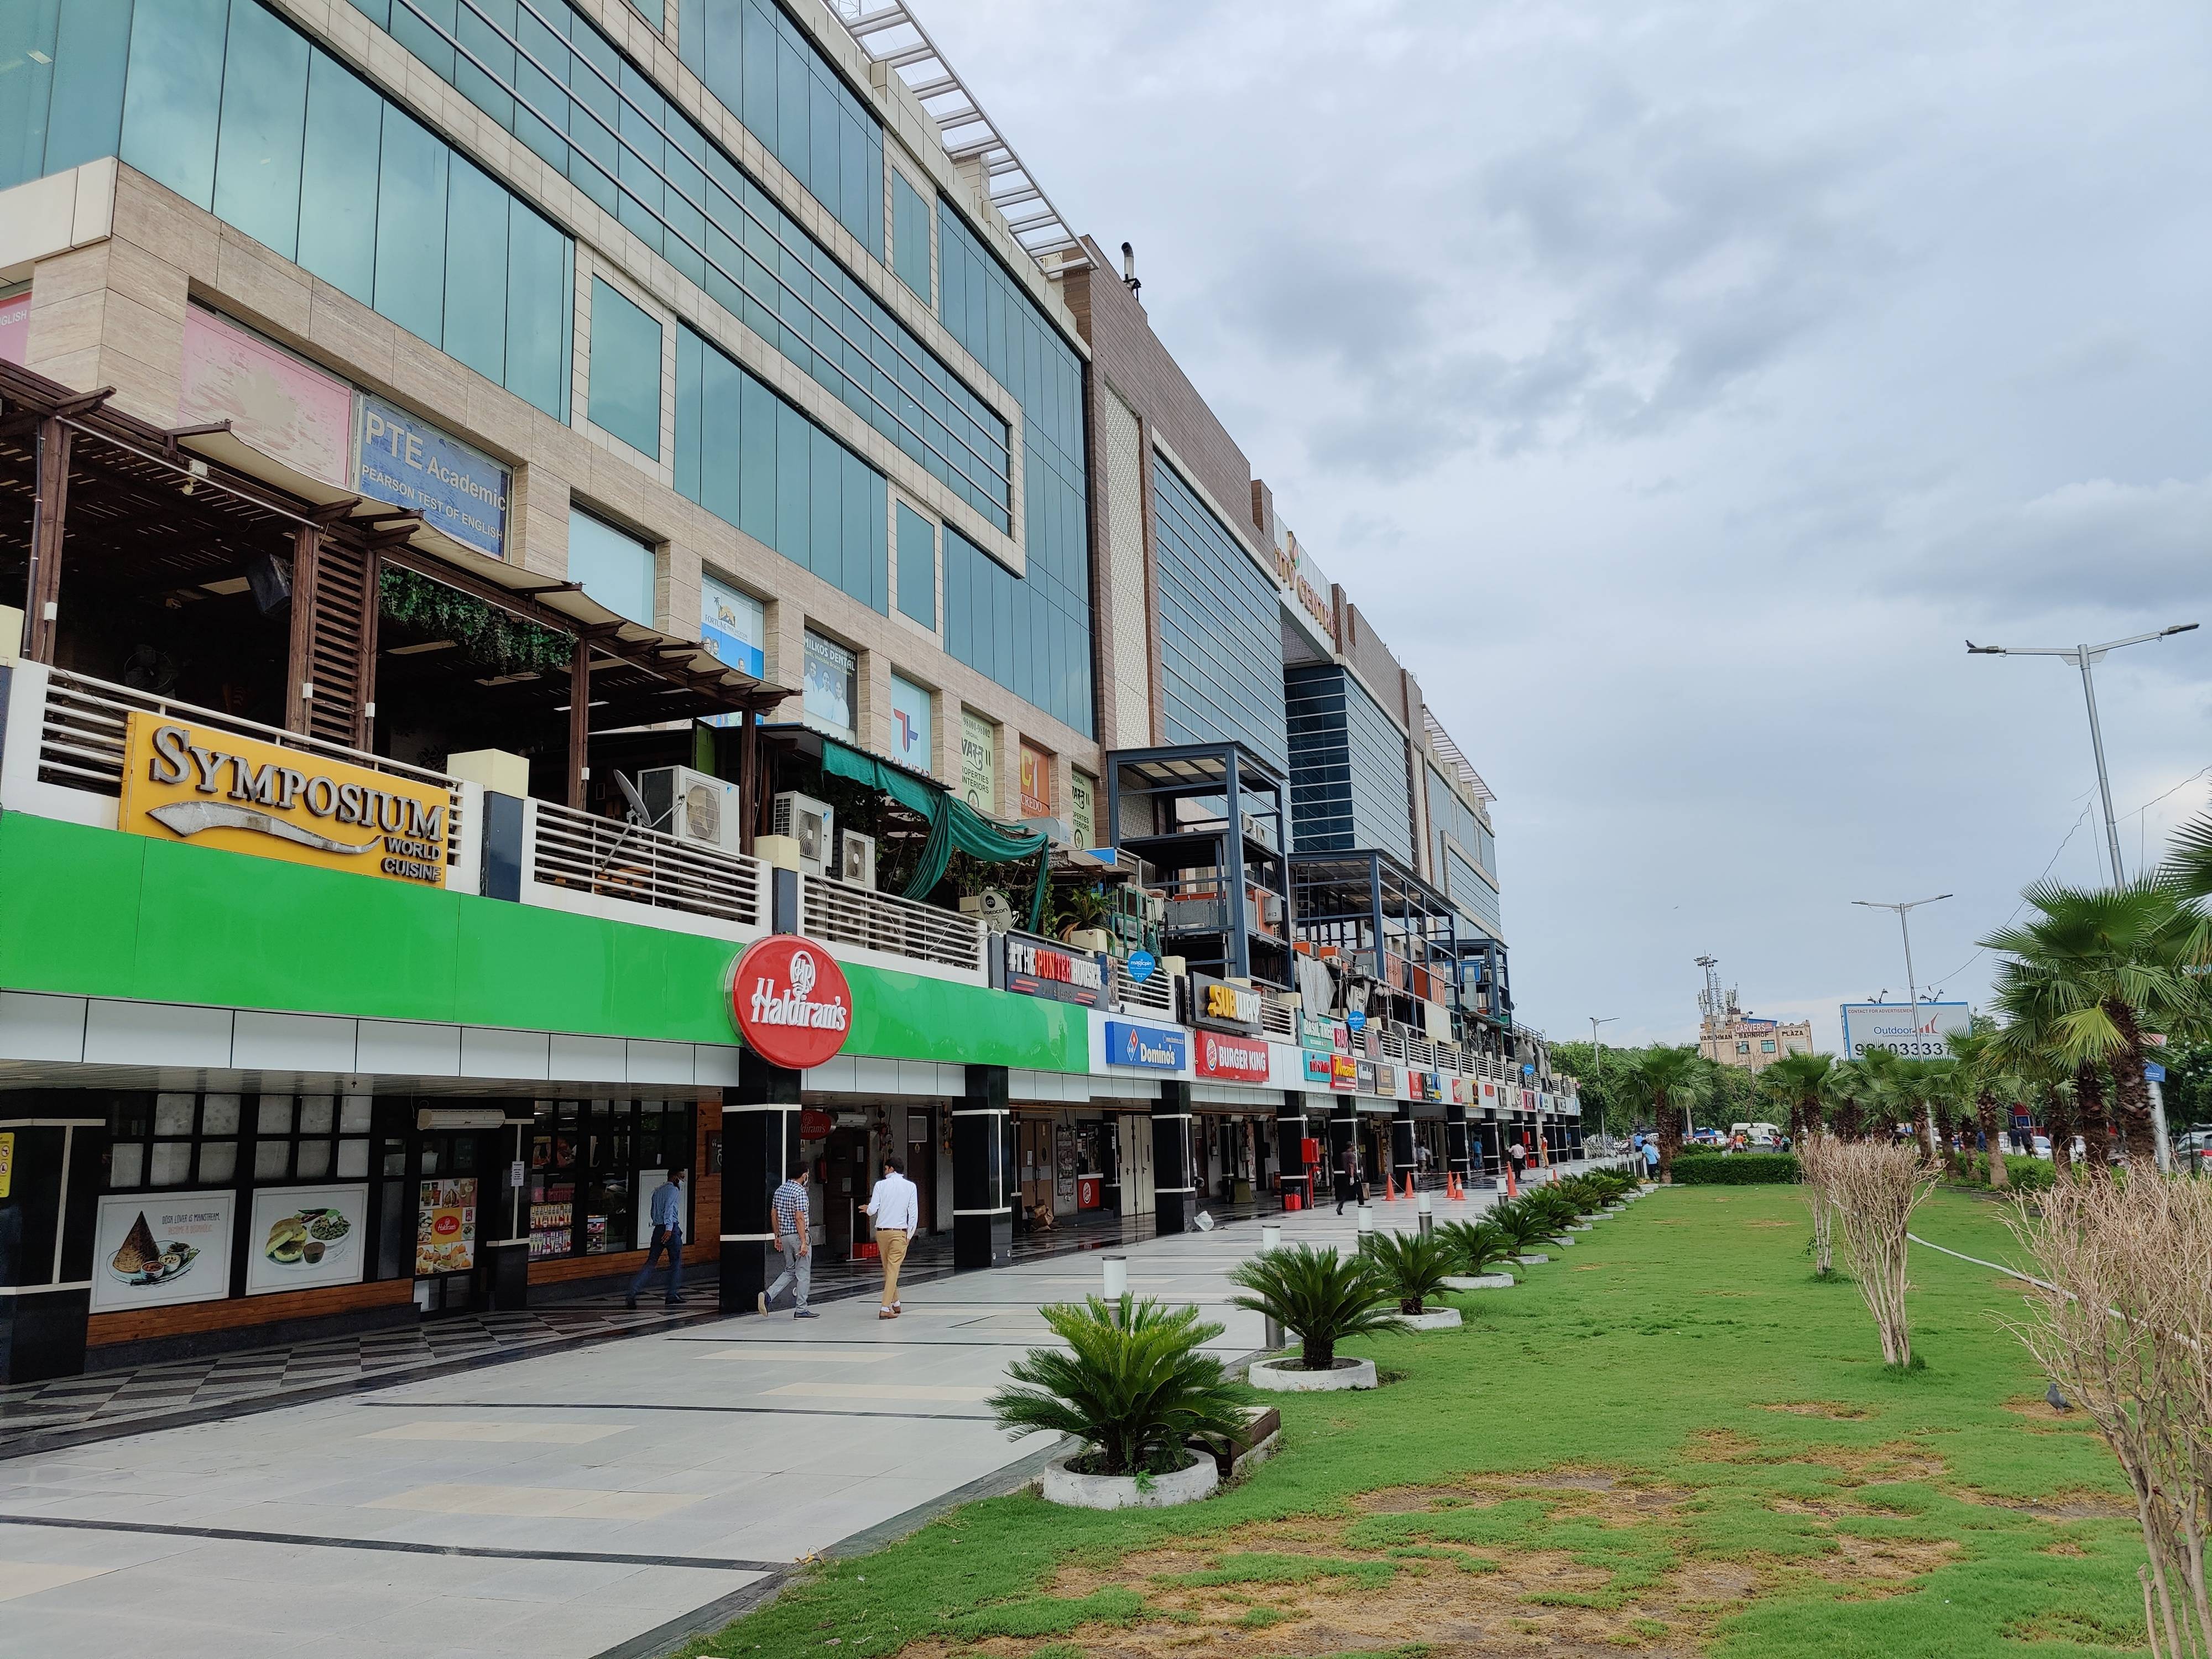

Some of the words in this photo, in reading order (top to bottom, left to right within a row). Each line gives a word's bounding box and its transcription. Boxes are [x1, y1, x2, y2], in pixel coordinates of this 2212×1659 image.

[0, 310, 27, 326] GLISH
[366, 411, 423, 470] PTE
[427, 456, 506, 512] Academic
[362, 464, 415, 499] PEARSON
[418, 491, 444, 513] TEST
[446, 507, 459, 519] OF
[462, 514, 503, 541] ENGLISH
[1297, 575, 1337, 640] CENTRE
[705, 614, 727, 630] FORTUNE
[830, 650, 855, 672] DENTAL
[149, 725, 446, 842] SYMPOSIUM
[962, 775, 989, 794] INTERIORS
[1020, 794, 1042, 813] CREDO
[384, 836, 441, 861] WORLD
[381, 857, 441, 882] CUISINE
[1130, 959, 1152, 967] magicpin
[751, 977, 847, 1031] Haldiram's
[1208, 984, 1262, 1024] SUBWAY
[1303, 1018, 1321, 1037] BASIL
[1334, 1027, 1349, 1048] BAR
[1735, 1023, 1765, 1033] CARVERS
[1140, 1042, 1175, 1066] Domino's
[1219, 1046, 1248, 1070] BURGER
[1249, 1051, 1266, 1072] KING
